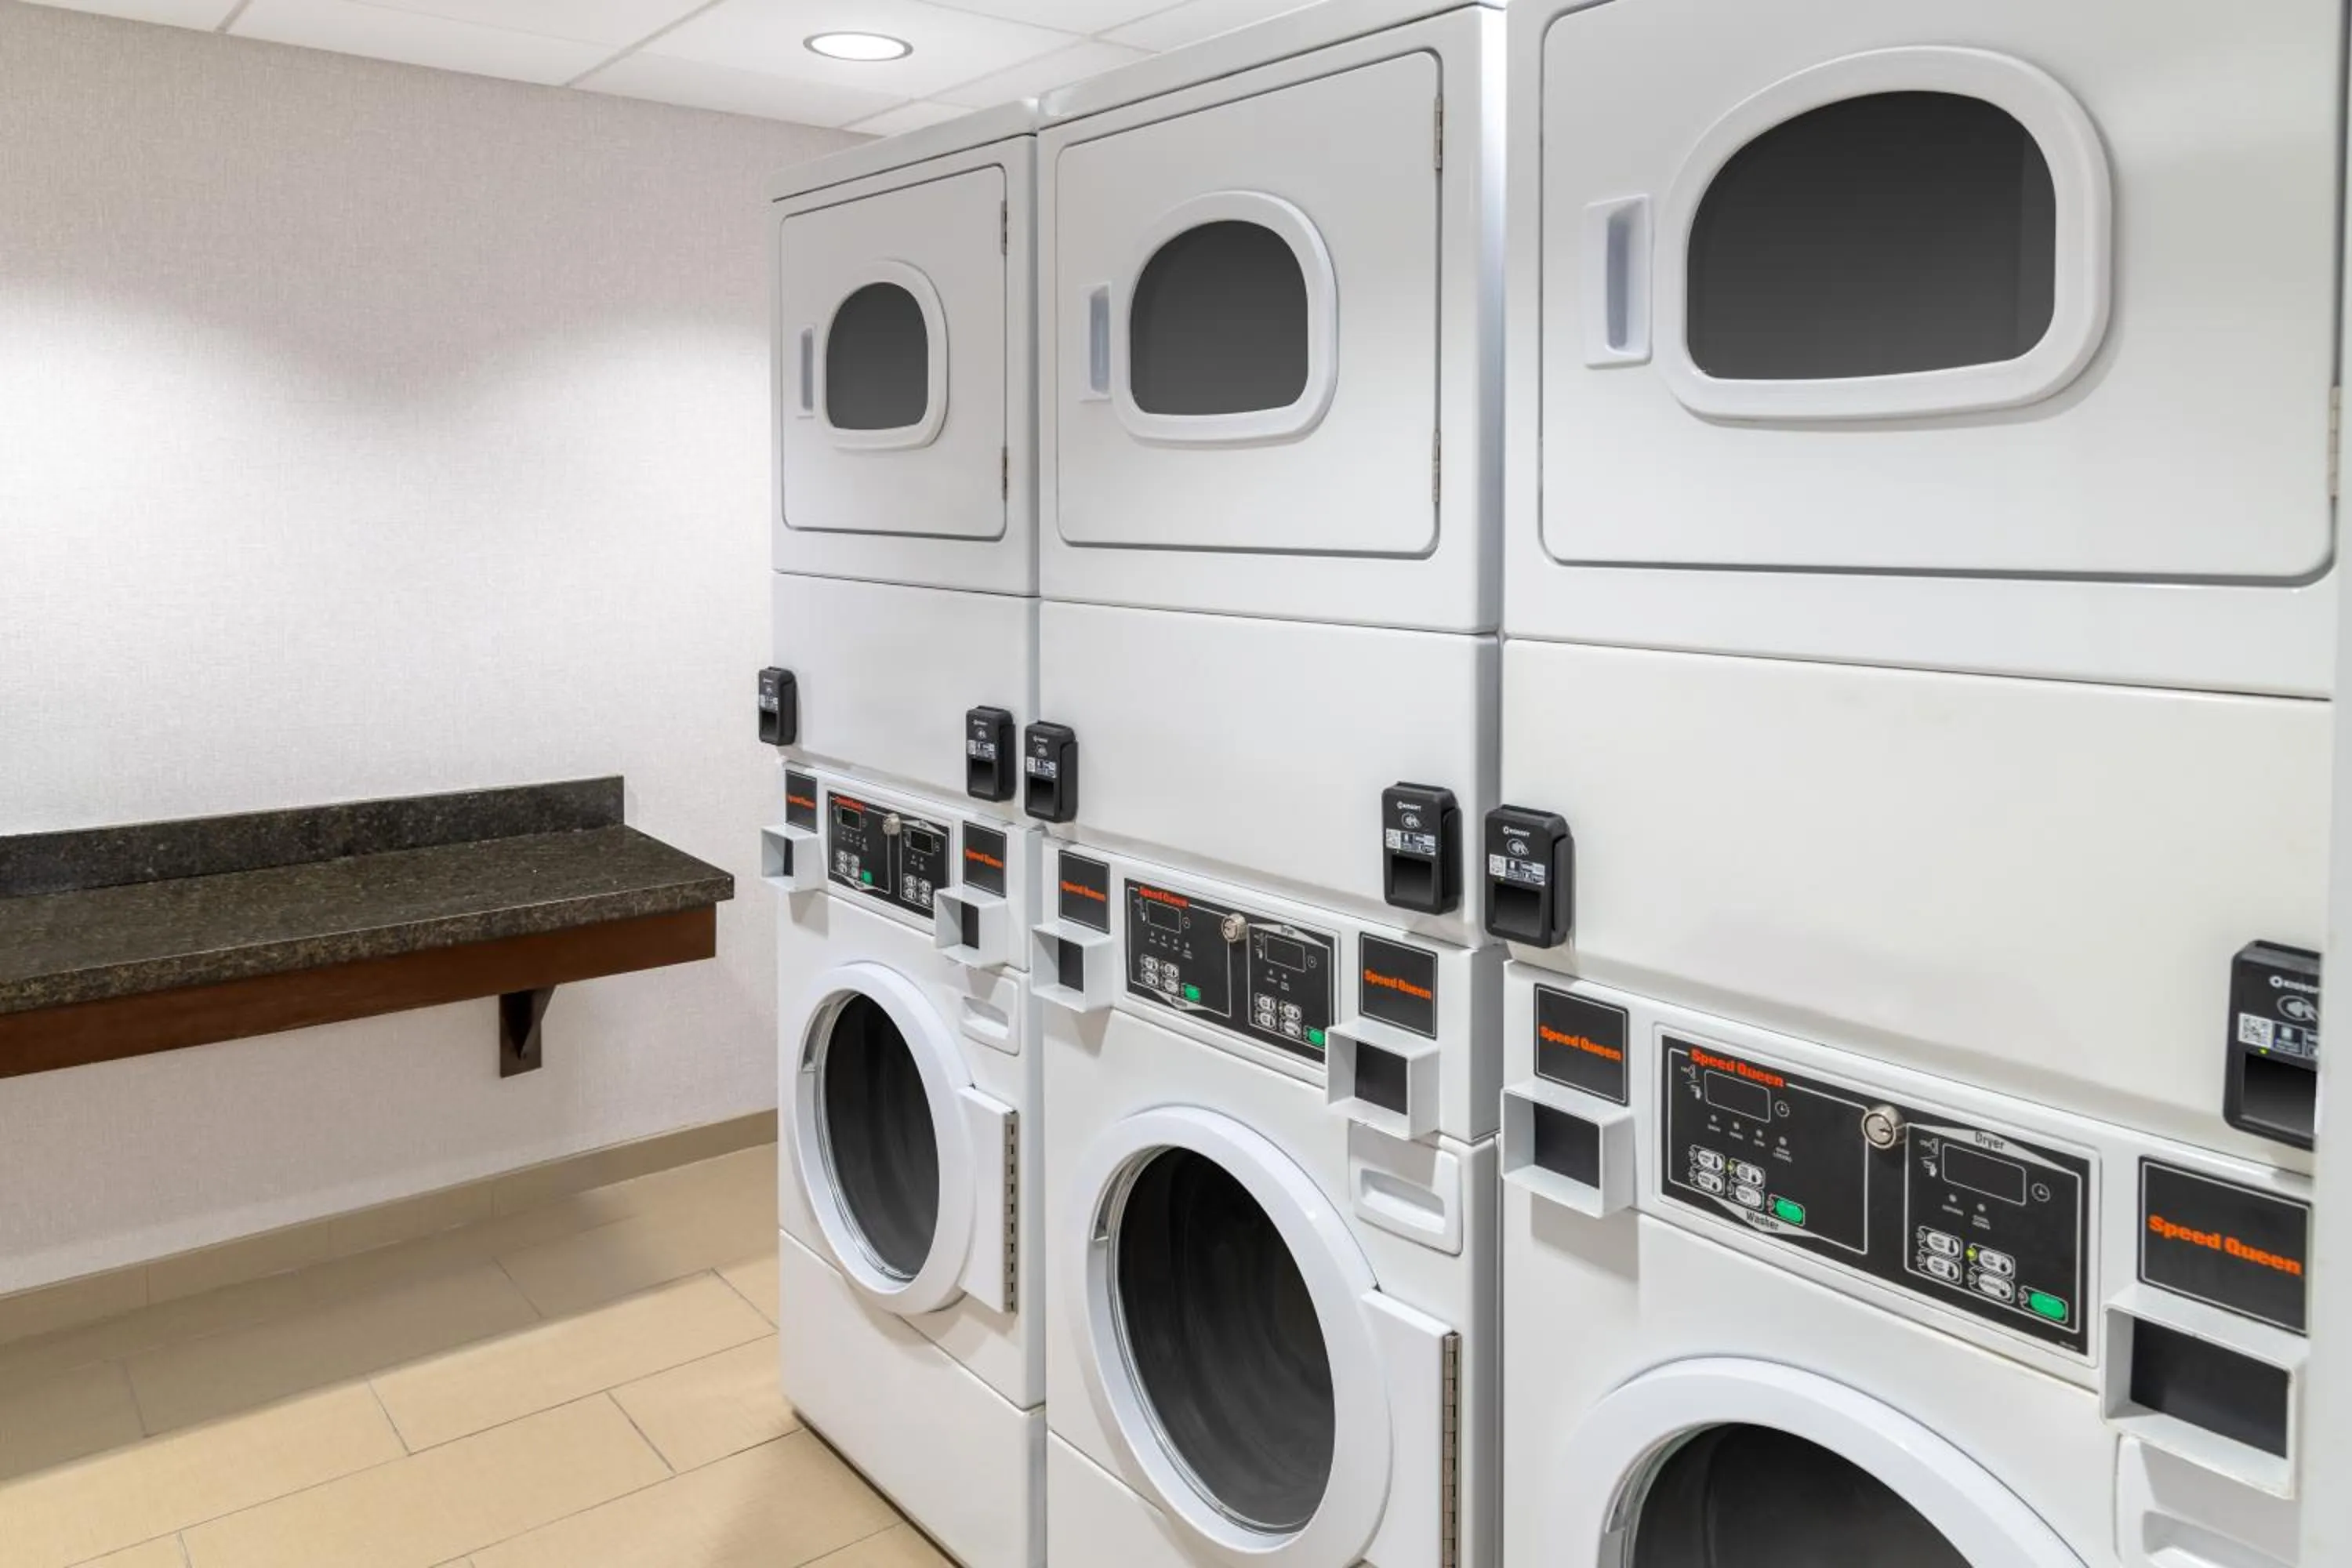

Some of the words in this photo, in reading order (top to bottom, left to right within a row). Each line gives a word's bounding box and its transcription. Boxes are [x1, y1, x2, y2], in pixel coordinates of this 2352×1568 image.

[1364, 968, 1397, 989] Speed
[1398, 978, 1432, 1000] Queen
[1539, 1024, 1579, 1049] Speed
[1580, 1036, 1621, 1062] Queen
[1691, 1048, 1735, 1073] Speed
[1737, 1061, 1785, 1088] Queen
[1975, 1131, 2004, 1150] Dryer
[1745, 1210, 1780, 1231] Washer
[2148, 1214, 2221, 1250] Speed
[2224, 1236, 2302, 1276] Queen
